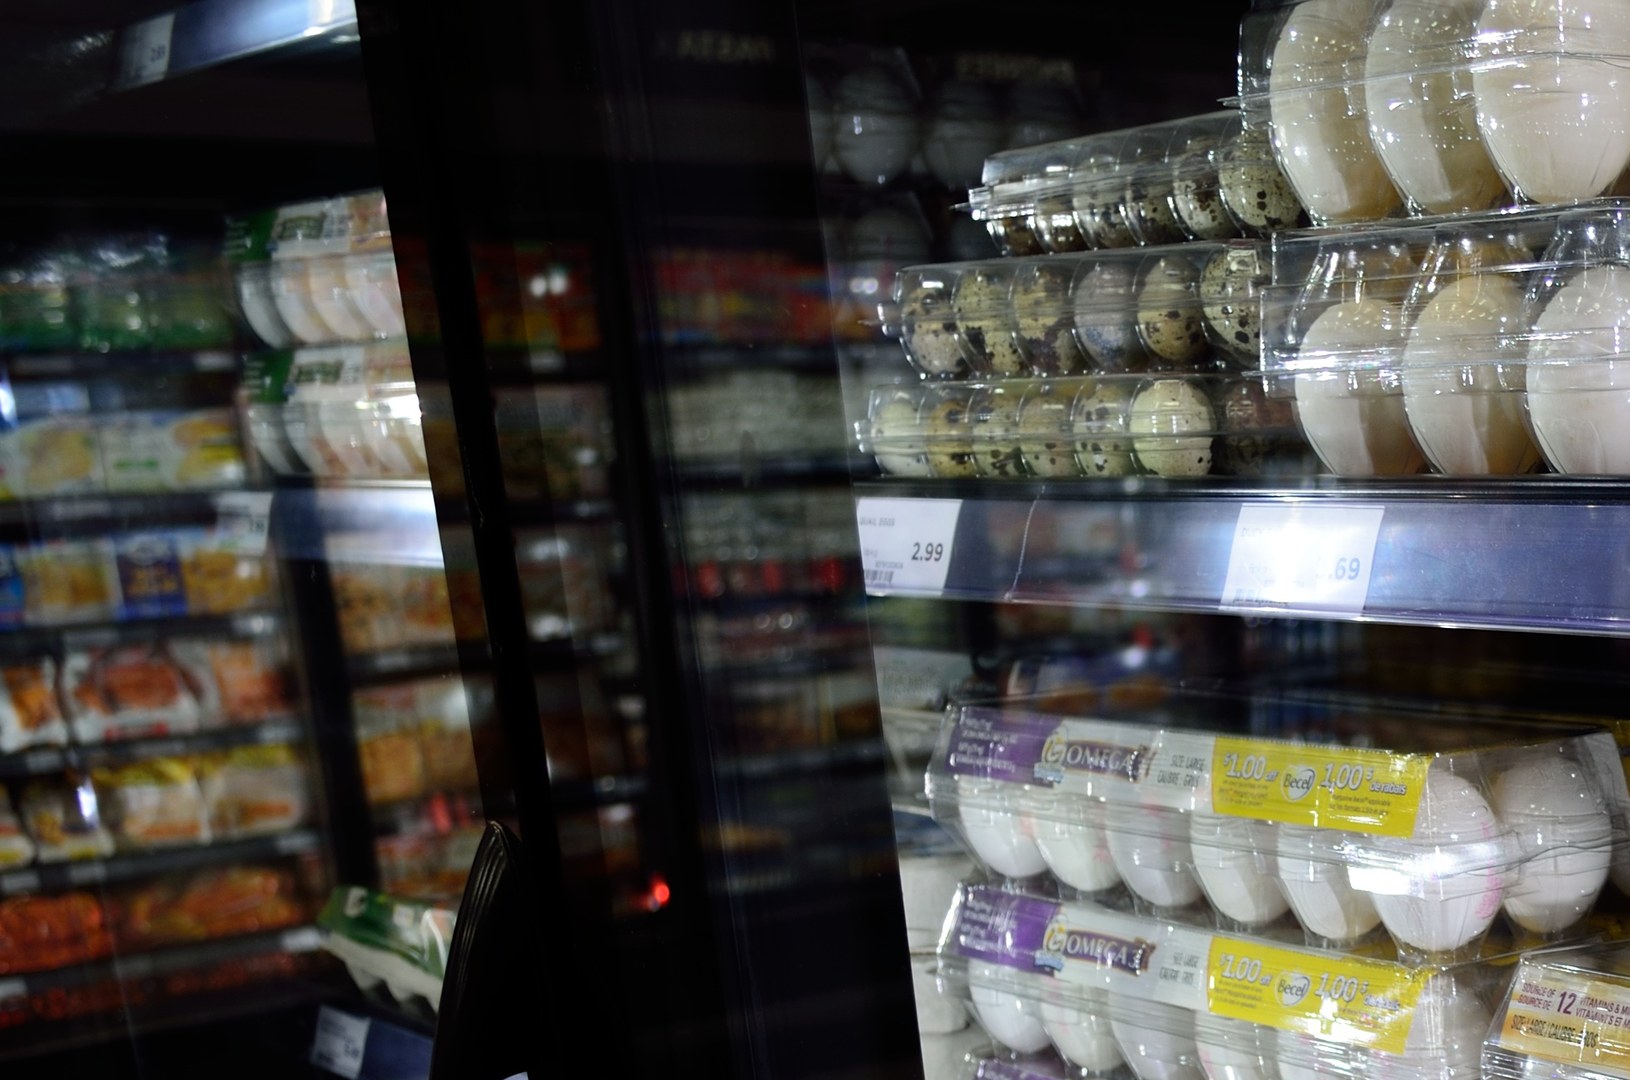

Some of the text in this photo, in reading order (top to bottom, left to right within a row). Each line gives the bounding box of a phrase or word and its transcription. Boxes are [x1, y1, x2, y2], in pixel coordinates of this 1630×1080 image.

[911, 541, 944, 562] 2.99
[1223, 752, 1266, 782] $1.00
[1283, 773, 1312, 790] Becel
[1067, 935, 1126, 964] OMEGA
[1278, 979, 1306, 997] Becel
[1522, 982, 1546, 996] SOURCE
[1557, 991, 1577, 1015] 12
